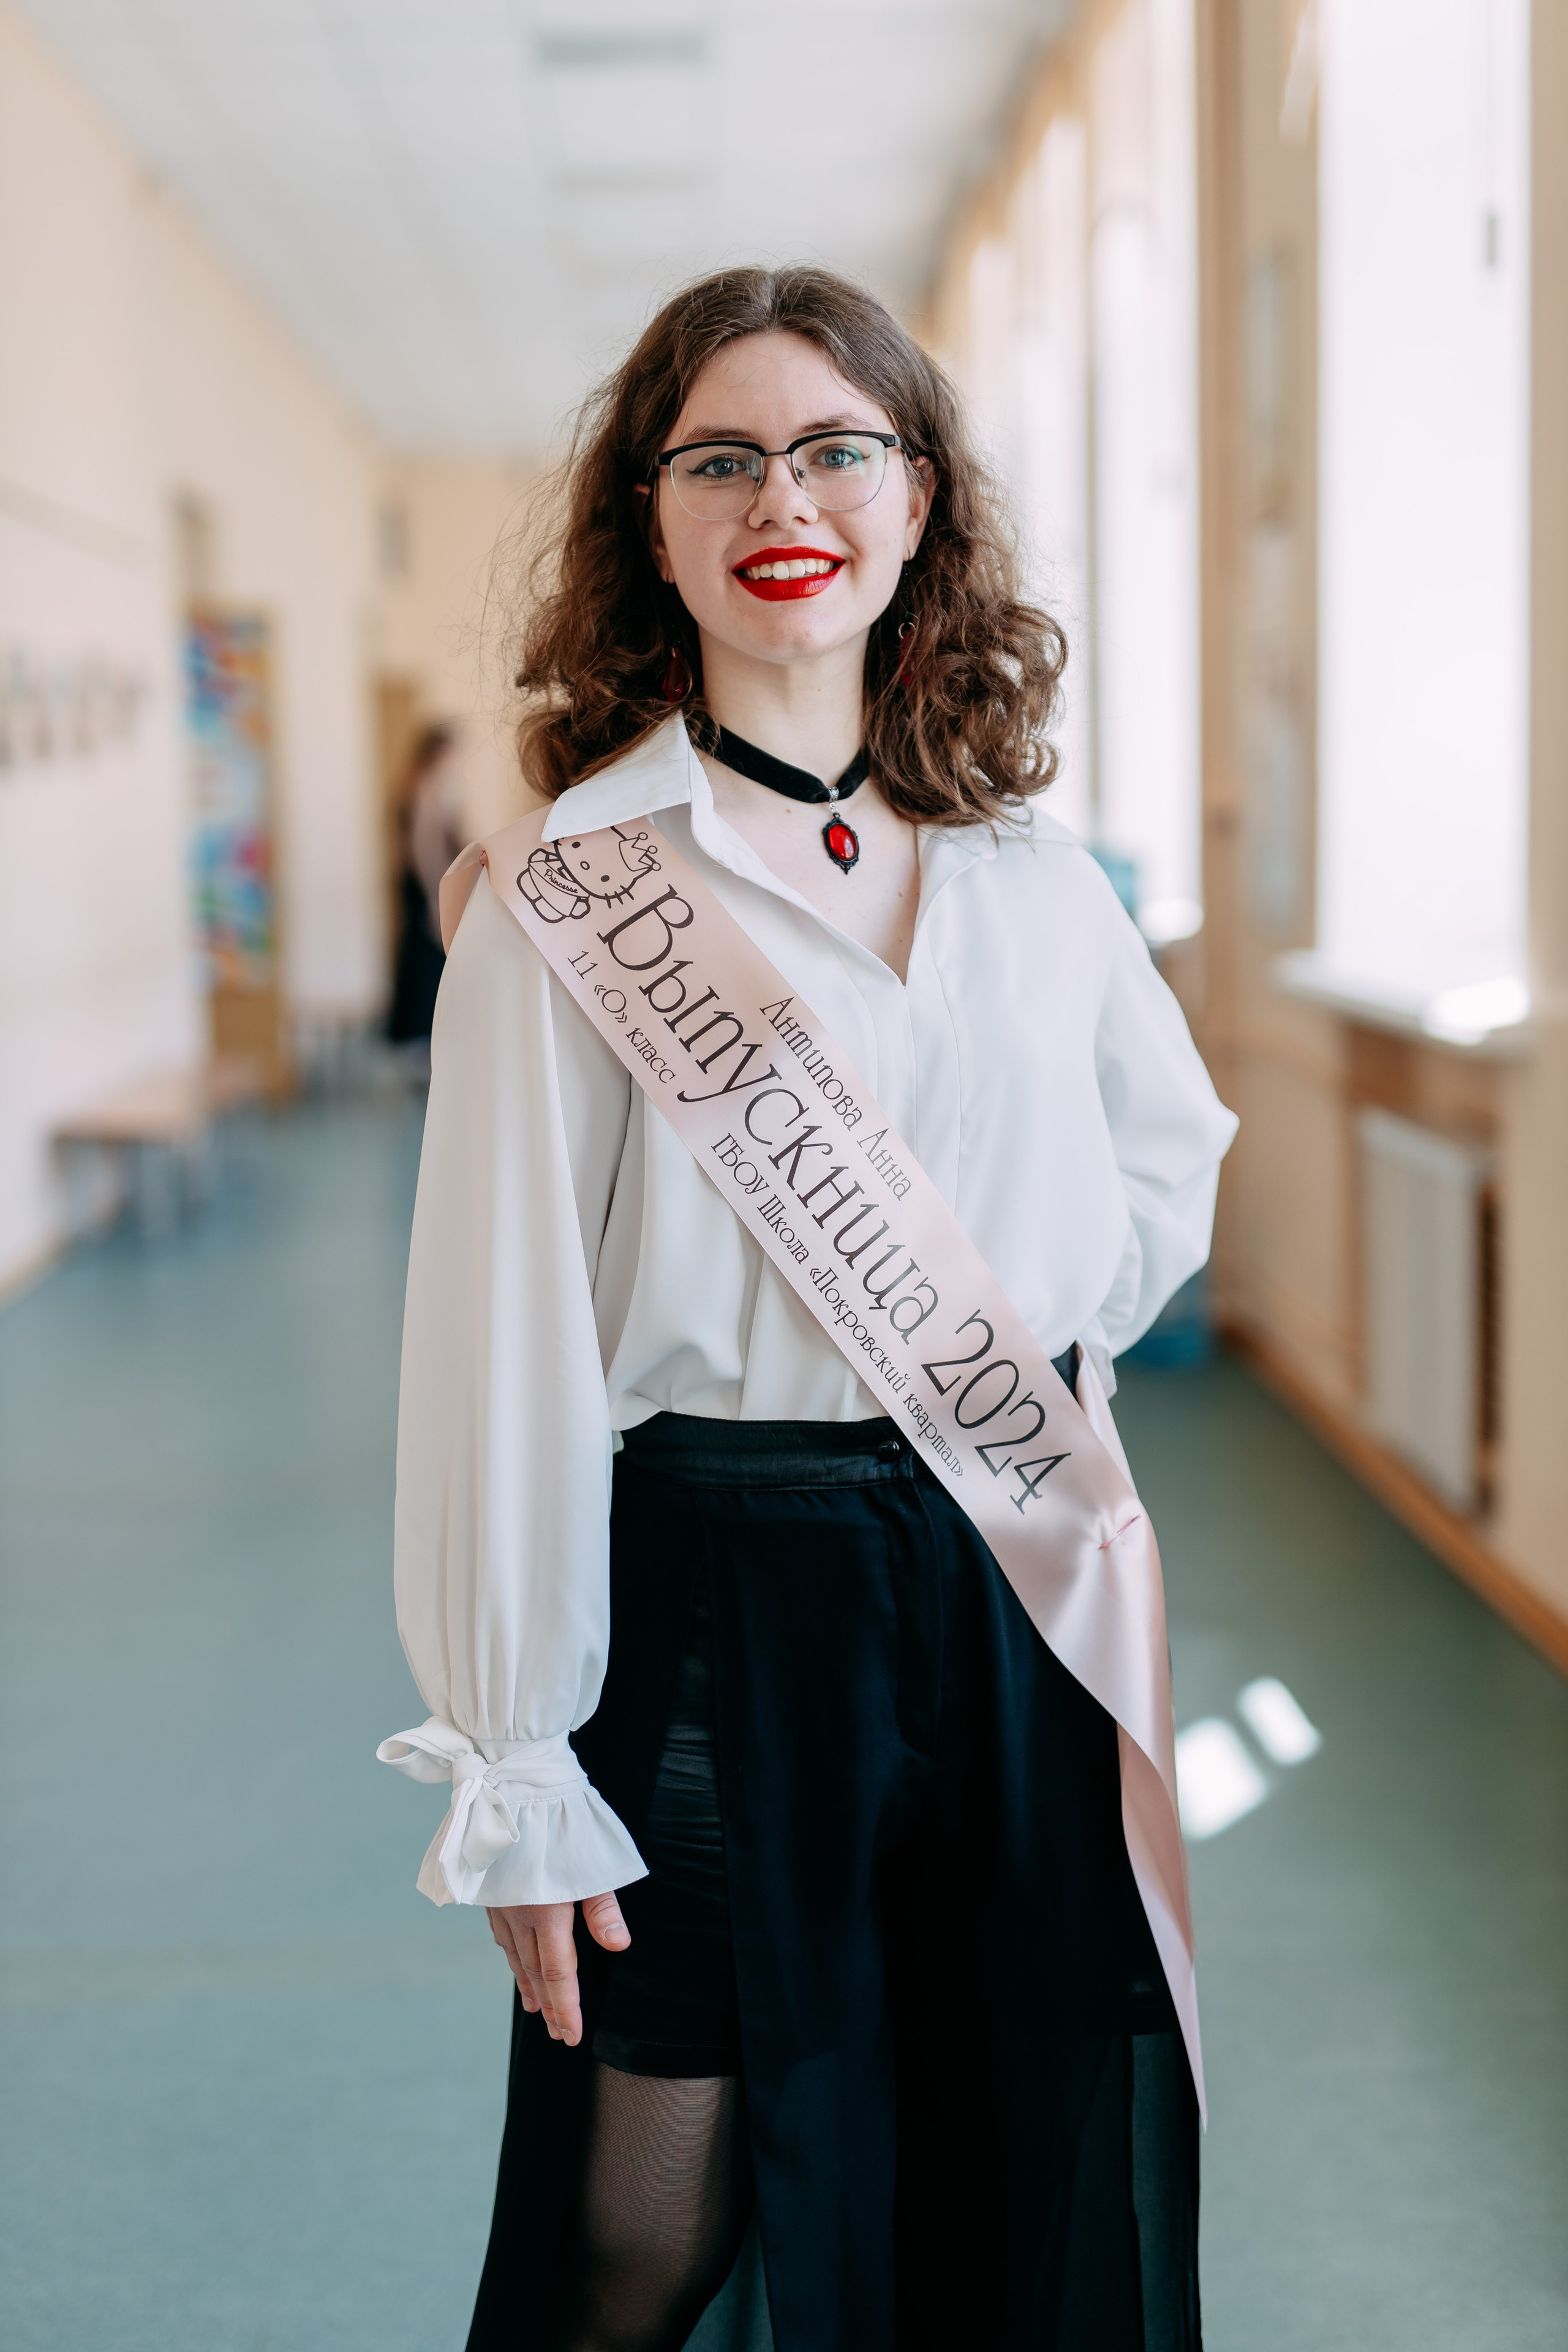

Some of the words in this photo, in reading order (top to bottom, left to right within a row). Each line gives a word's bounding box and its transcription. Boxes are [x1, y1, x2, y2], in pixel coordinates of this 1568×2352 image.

[543, 869, 578, 894] Princesse
[567, 951, 598, 980] 11
[594, 984, 628, 1023] «О»
[625, 1027, 676, 1084] класс
[759, 997, 862, 1132] Антипова
[857, 1128, 911, 1201] Анна
[597, 883, 939, 1346] Выпускница
[921, 1308, 1072, 1515] 2024
[710, 1133, 770, 1194] ГБОУ
[756, 1194, 809, 1265] Школа
[809, 1267, 911, 1394] «Покровский
[902, 1393, 963, 1477] квартал»
